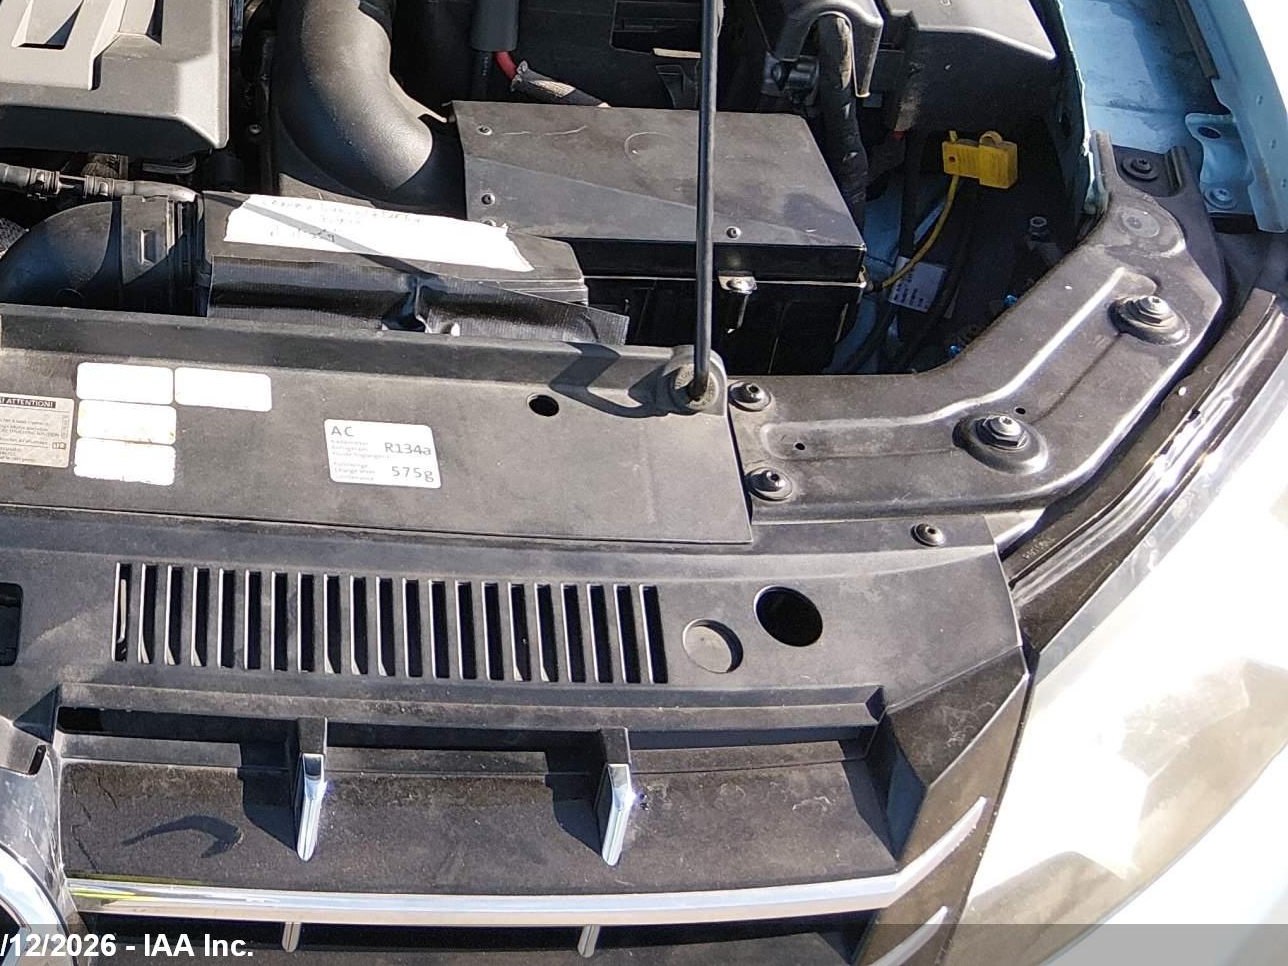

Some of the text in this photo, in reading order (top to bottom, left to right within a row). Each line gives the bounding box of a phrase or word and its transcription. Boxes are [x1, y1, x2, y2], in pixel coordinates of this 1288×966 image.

[6, 397, 54, 408] ATTENTION!
[330, 425, 354, 437] AC
[384, 442, 432, 455] R134a
[392, 465, 435, 483] 575g
